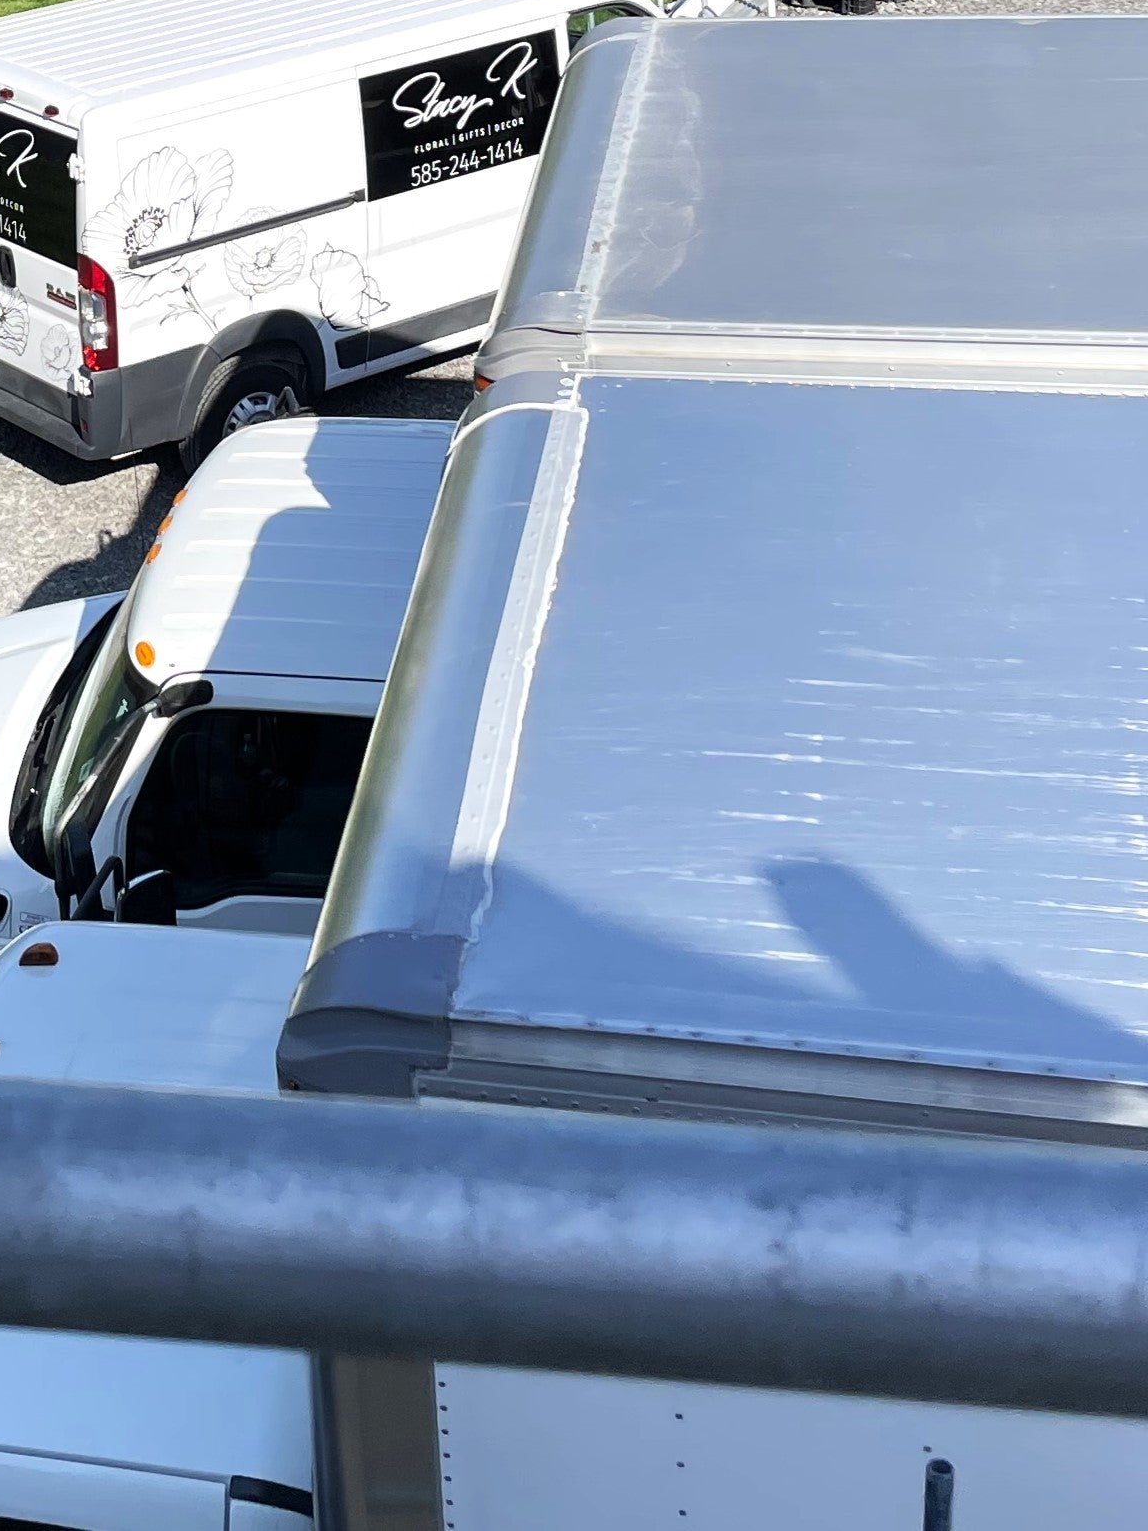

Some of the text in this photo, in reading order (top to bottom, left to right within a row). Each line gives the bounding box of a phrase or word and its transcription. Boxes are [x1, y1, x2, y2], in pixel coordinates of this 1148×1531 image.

[392, 41, 538, 130] Stacy K
[414, 116, 525, 155] FLORAL GIFTS DECOR
[410, 137, 524, 188] 585-244-1414
[0, 196, 25, 213] DECOR
